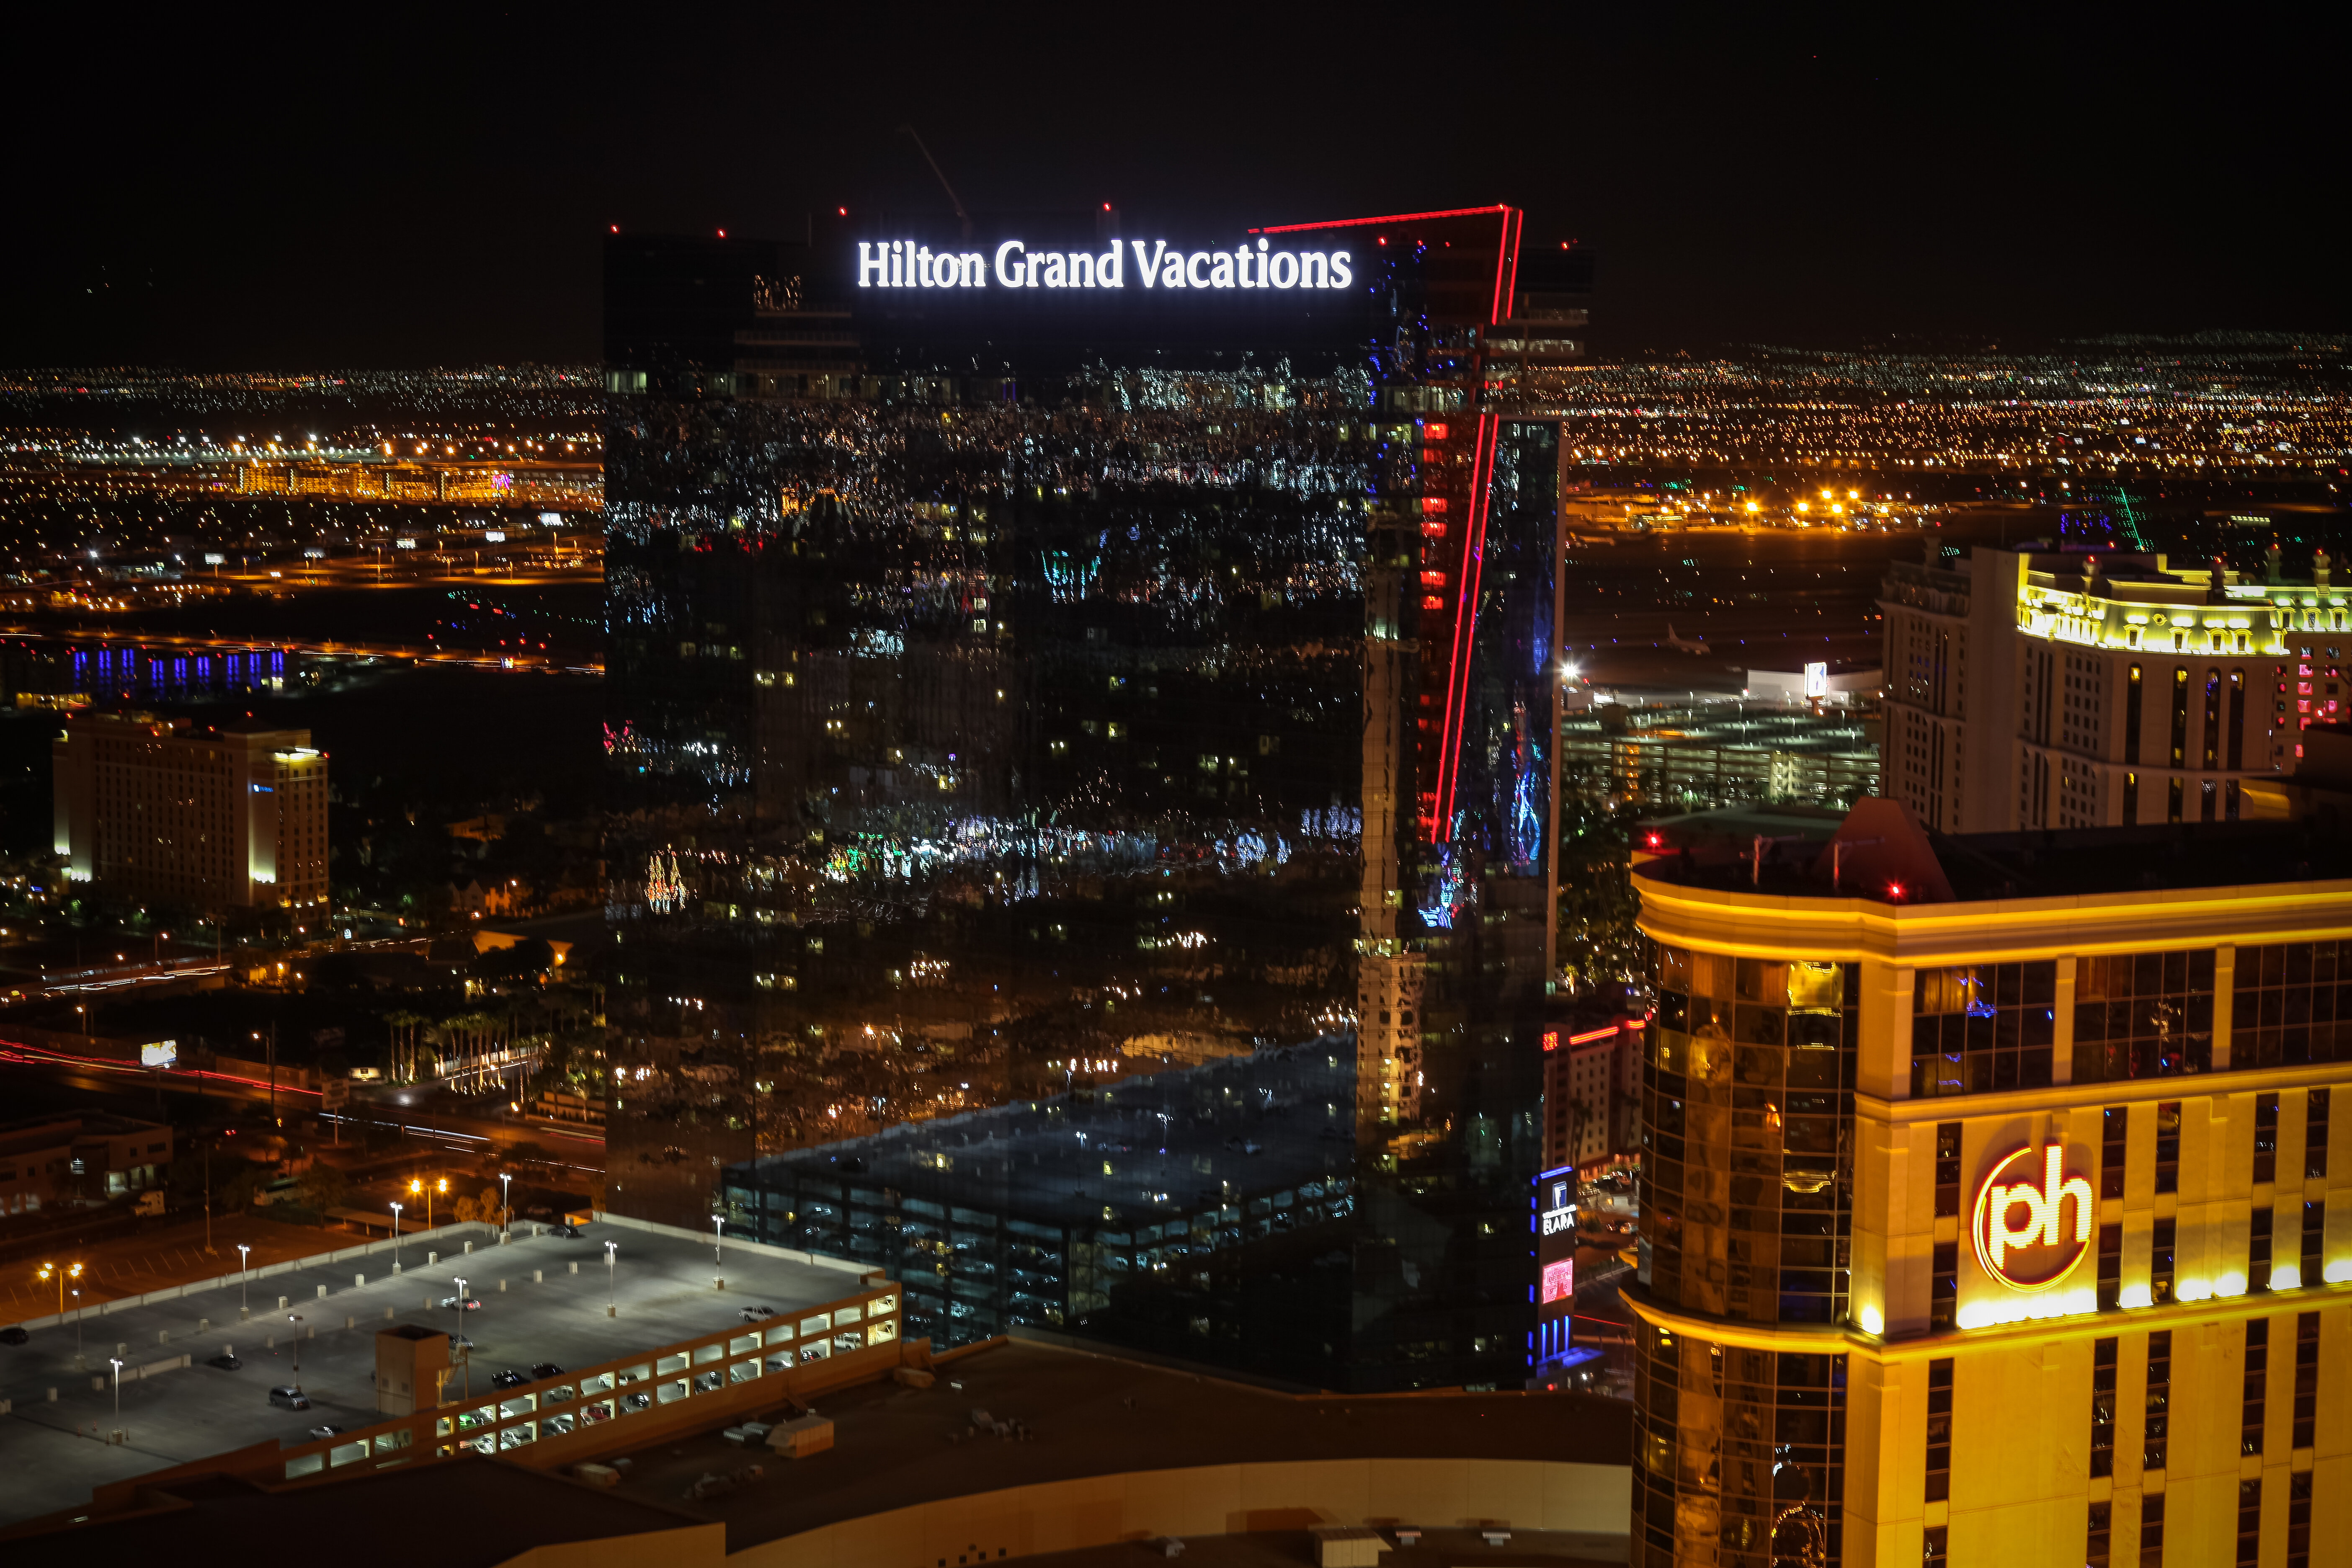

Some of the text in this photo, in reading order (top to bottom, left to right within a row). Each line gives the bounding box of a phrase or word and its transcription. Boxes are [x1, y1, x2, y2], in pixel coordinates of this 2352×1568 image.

[858, 237, 1352, 289] Hilton Grand Vacations
[1543, 1212, 1575, 1236] ELARA
[1989, 1145, 2093, 1270] ph
